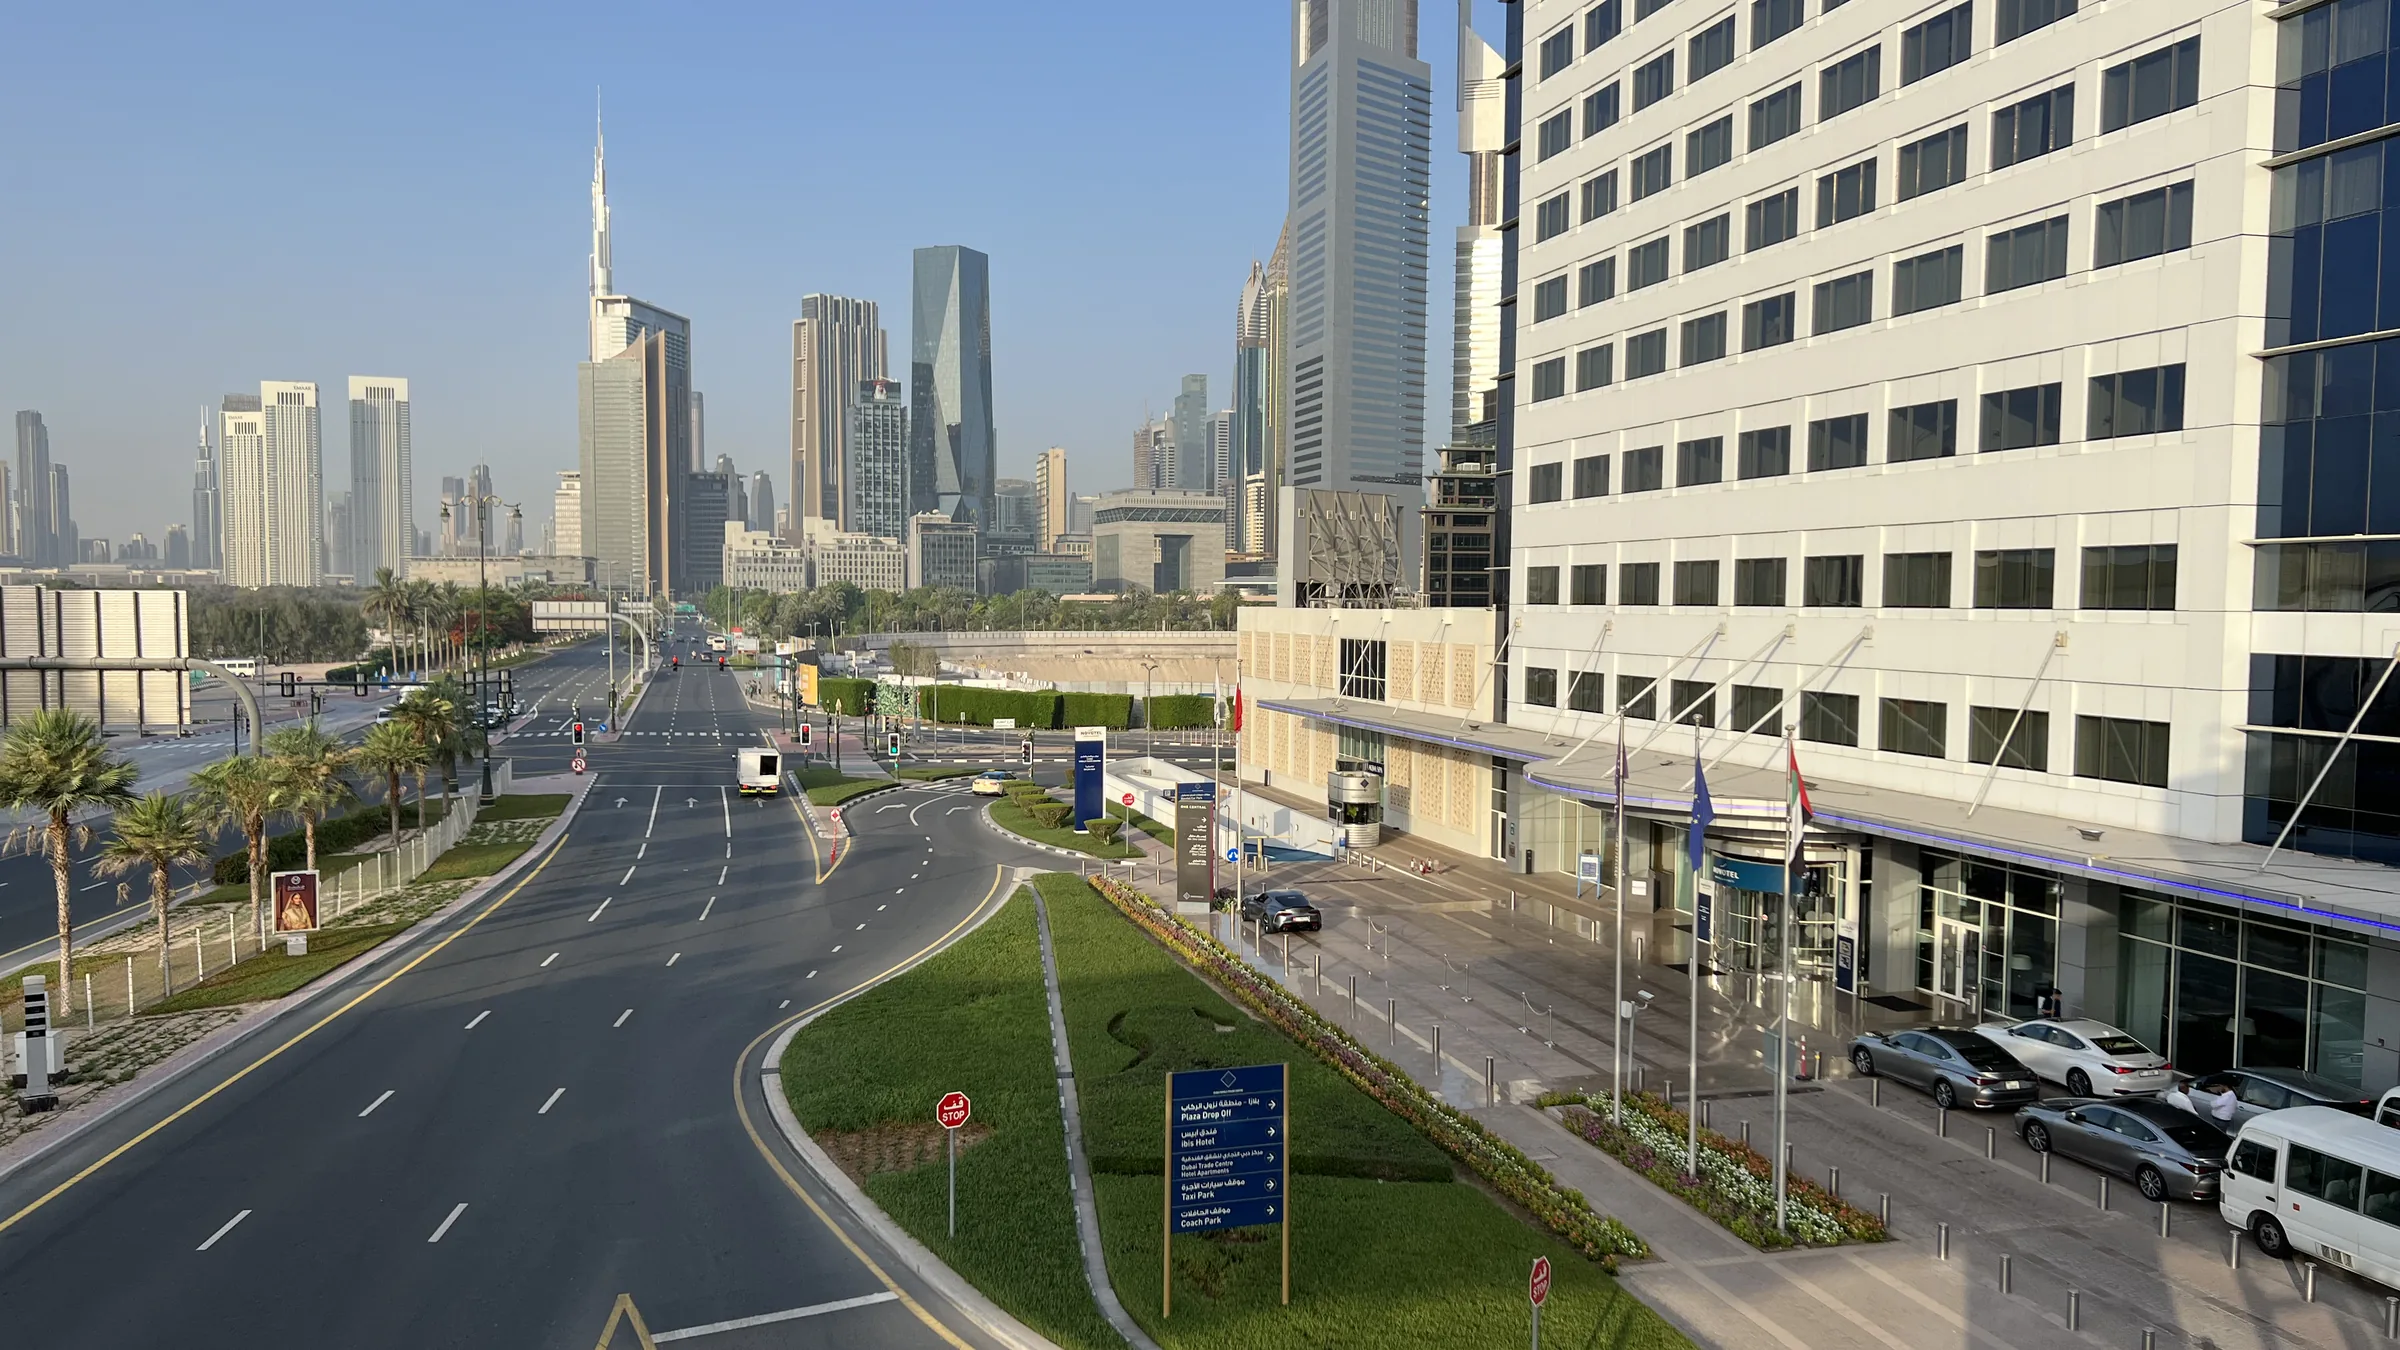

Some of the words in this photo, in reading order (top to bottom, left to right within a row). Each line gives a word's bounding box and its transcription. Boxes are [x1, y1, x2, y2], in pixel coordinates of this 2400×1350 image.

[1713, 866, 1740, 880] NOVOTEL
[943, 1096, 964, 1110] قف
[1181, 1102, 1202, 1112] الركاب
[1203, 1100, 1218, 1110] نزول
[1218, 1099, 1242, 1107] منطقة
[942, 1110, 965, 1122] STOP
[1181, 1112, 1201, 1122] Plaza
[1202, 1111, 1220, 1120] Drop
[1221, 1109, 1232, 1118] Off
[1199, 1128, 1218, 1137] فندق
[1196, 1137, 1215, 1147] Hotel
[1197, 1168, 1229, 1177] Apartments
[1181, 1183, 1200, 1191] الأجرة
[1201, 1181, 1224, 1189] سيارات
[1224, 1178, 1245, 1186] موقف
[1181, 1193, 1196, 1201] Taxi
[1198, 1190, 1214, 1200] Park
[1181, 1209, 1209, 1218] الحافلات
[1181, 1219, 1203, 1228] Coach
[1205, 1216, 1222, 1226] Park
[1533, 1279, 1547, 1299] STOP
